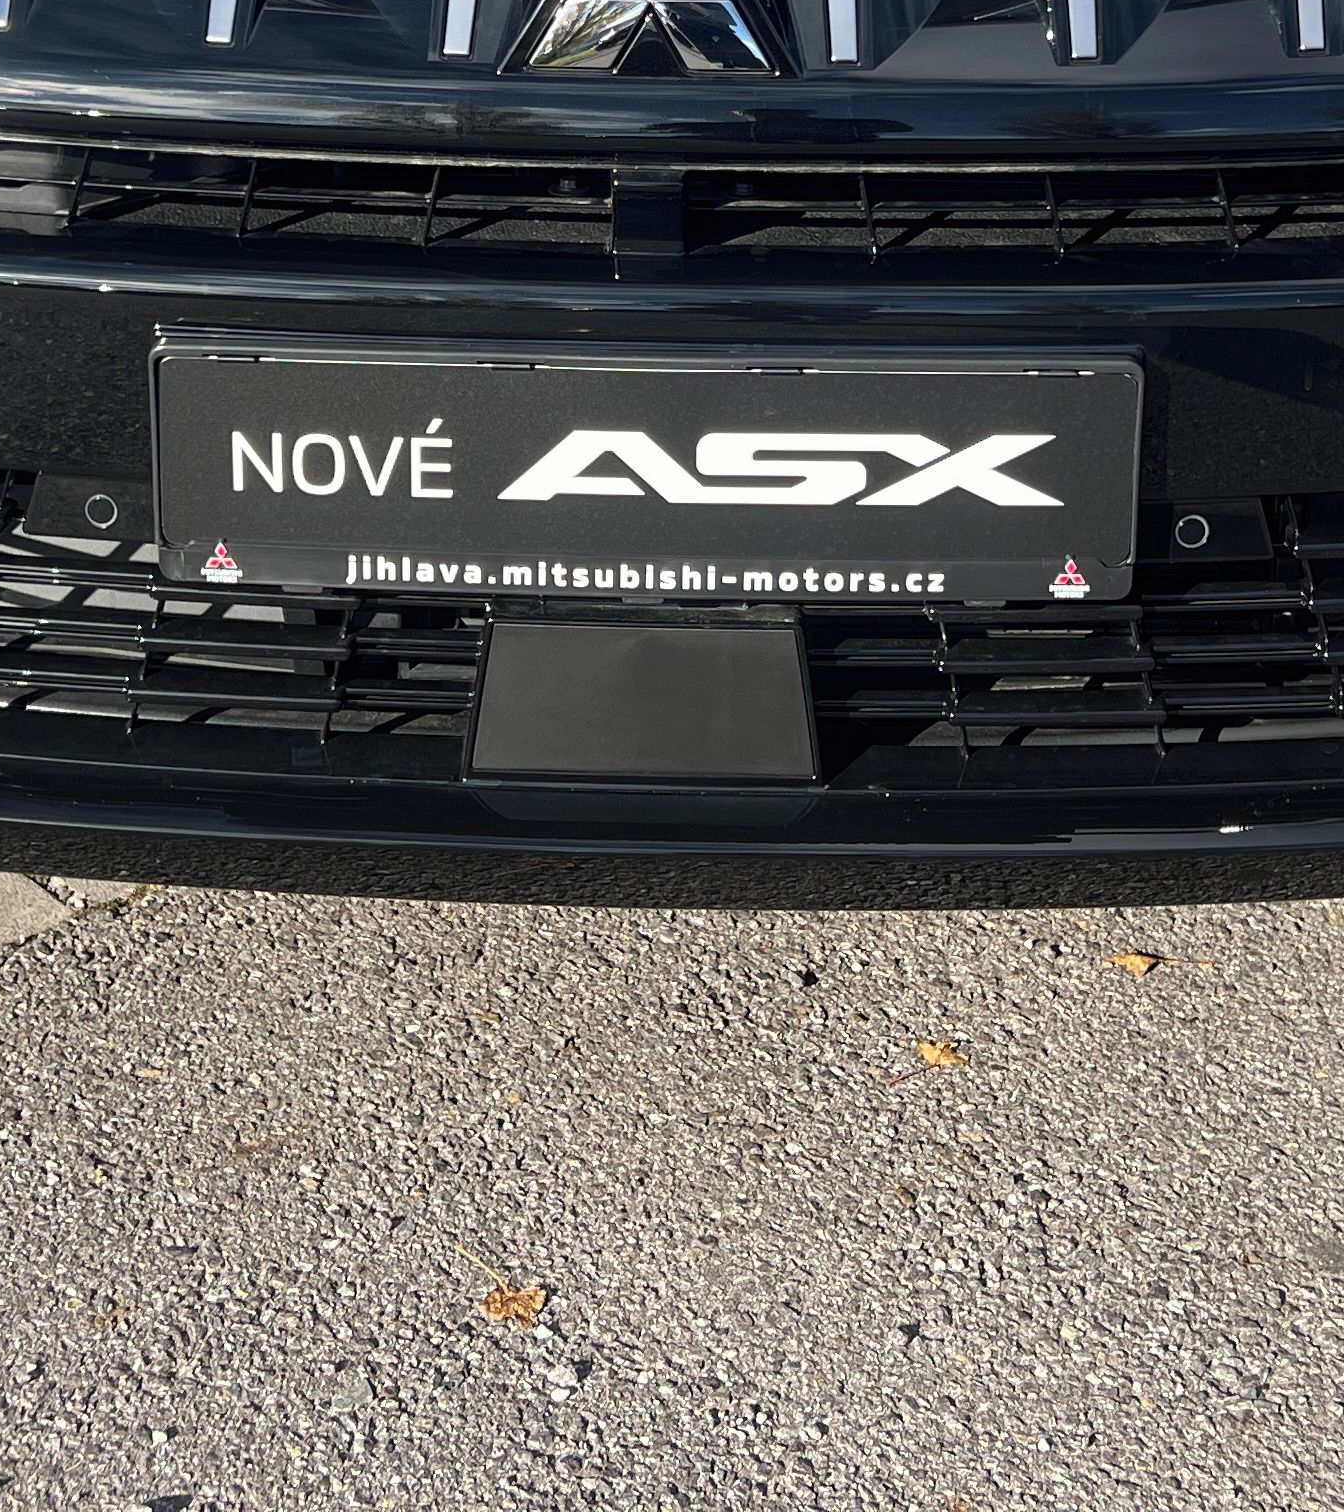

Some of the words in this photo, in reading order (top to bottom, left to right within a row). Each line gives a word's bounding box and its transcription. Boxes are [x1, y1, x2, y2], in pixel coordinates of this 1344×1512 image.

[231, 418, 454, 499] NOVÉ
[497, 429, 1065, 507] ASX
[345, 554, 945, 593] jihlava.mitsubishi-motors.cz
